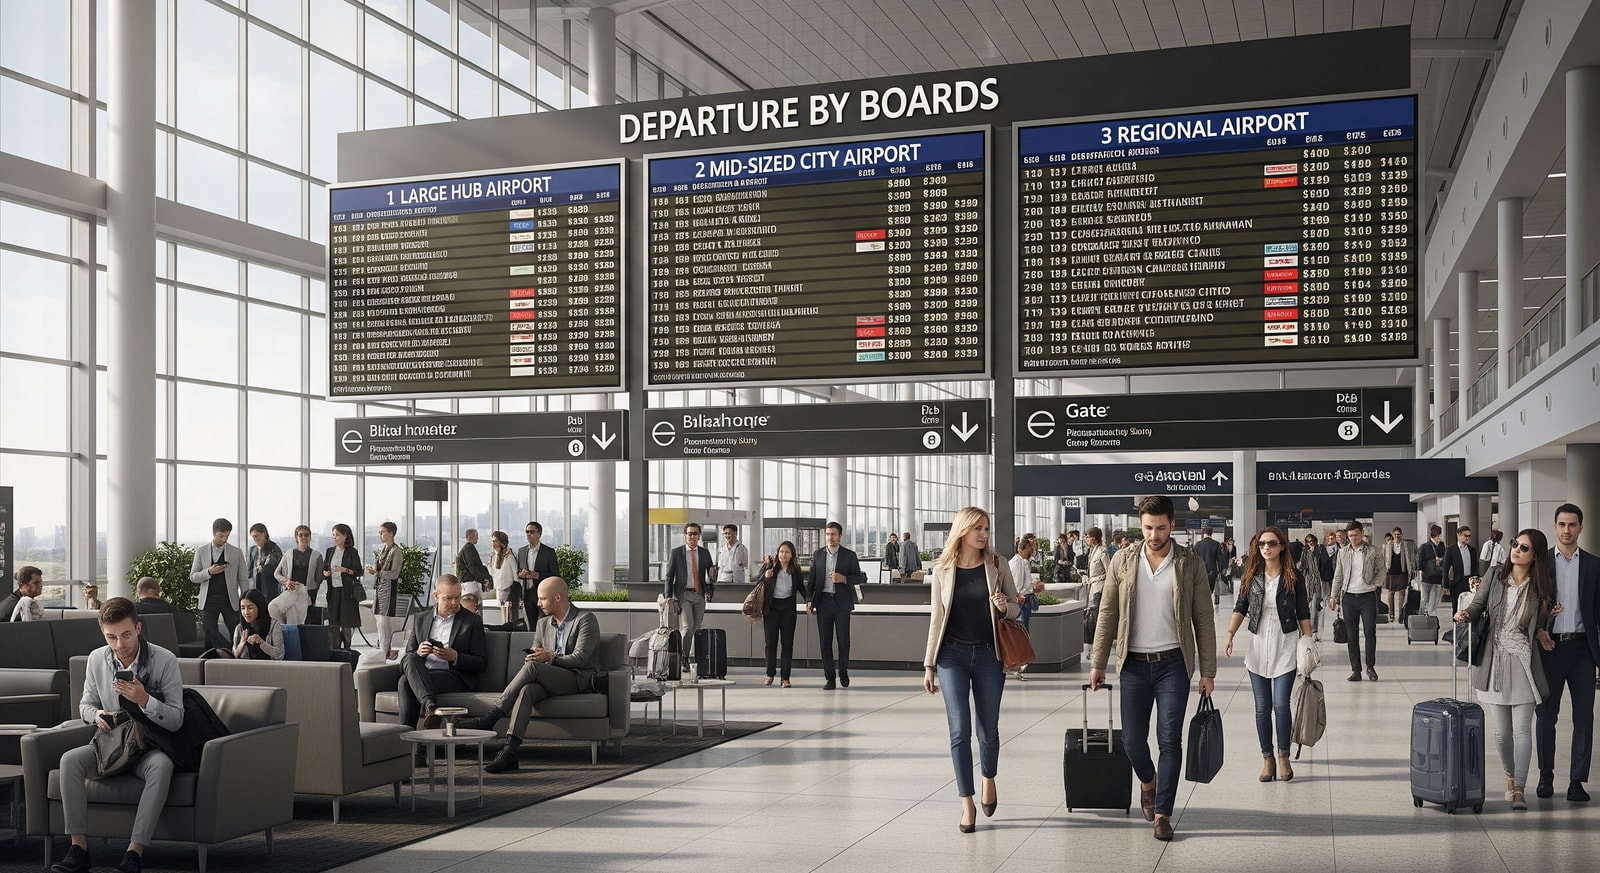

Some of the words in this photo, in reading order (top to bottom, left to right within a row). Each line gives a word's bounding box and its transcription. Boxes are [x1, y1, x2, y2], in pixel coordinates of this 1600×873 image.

[620, 99, 799, 144] DEPARTURE
[810, 94, 850, 129] BY
[860, 78, 1000, 121] BOARDS
[1101, 127, 1113, 145] 3
[1118, 118, 1219, 143] REGIONAL
[1220, 112, 1309, 136] AIRPORT
[694, 161, 706, 178] 2
[708, 155, 796, 177] MID-SIZED
[799, 151, 842, 170] CITY
[843, 143, 922, 165] AIRPORT
[386, 190, 395, 206] 1
[400, 185, 448, 205] LARGE
[451, 182, 482, 200] HUB
[485, 176, 553, 197] AIRPORT
